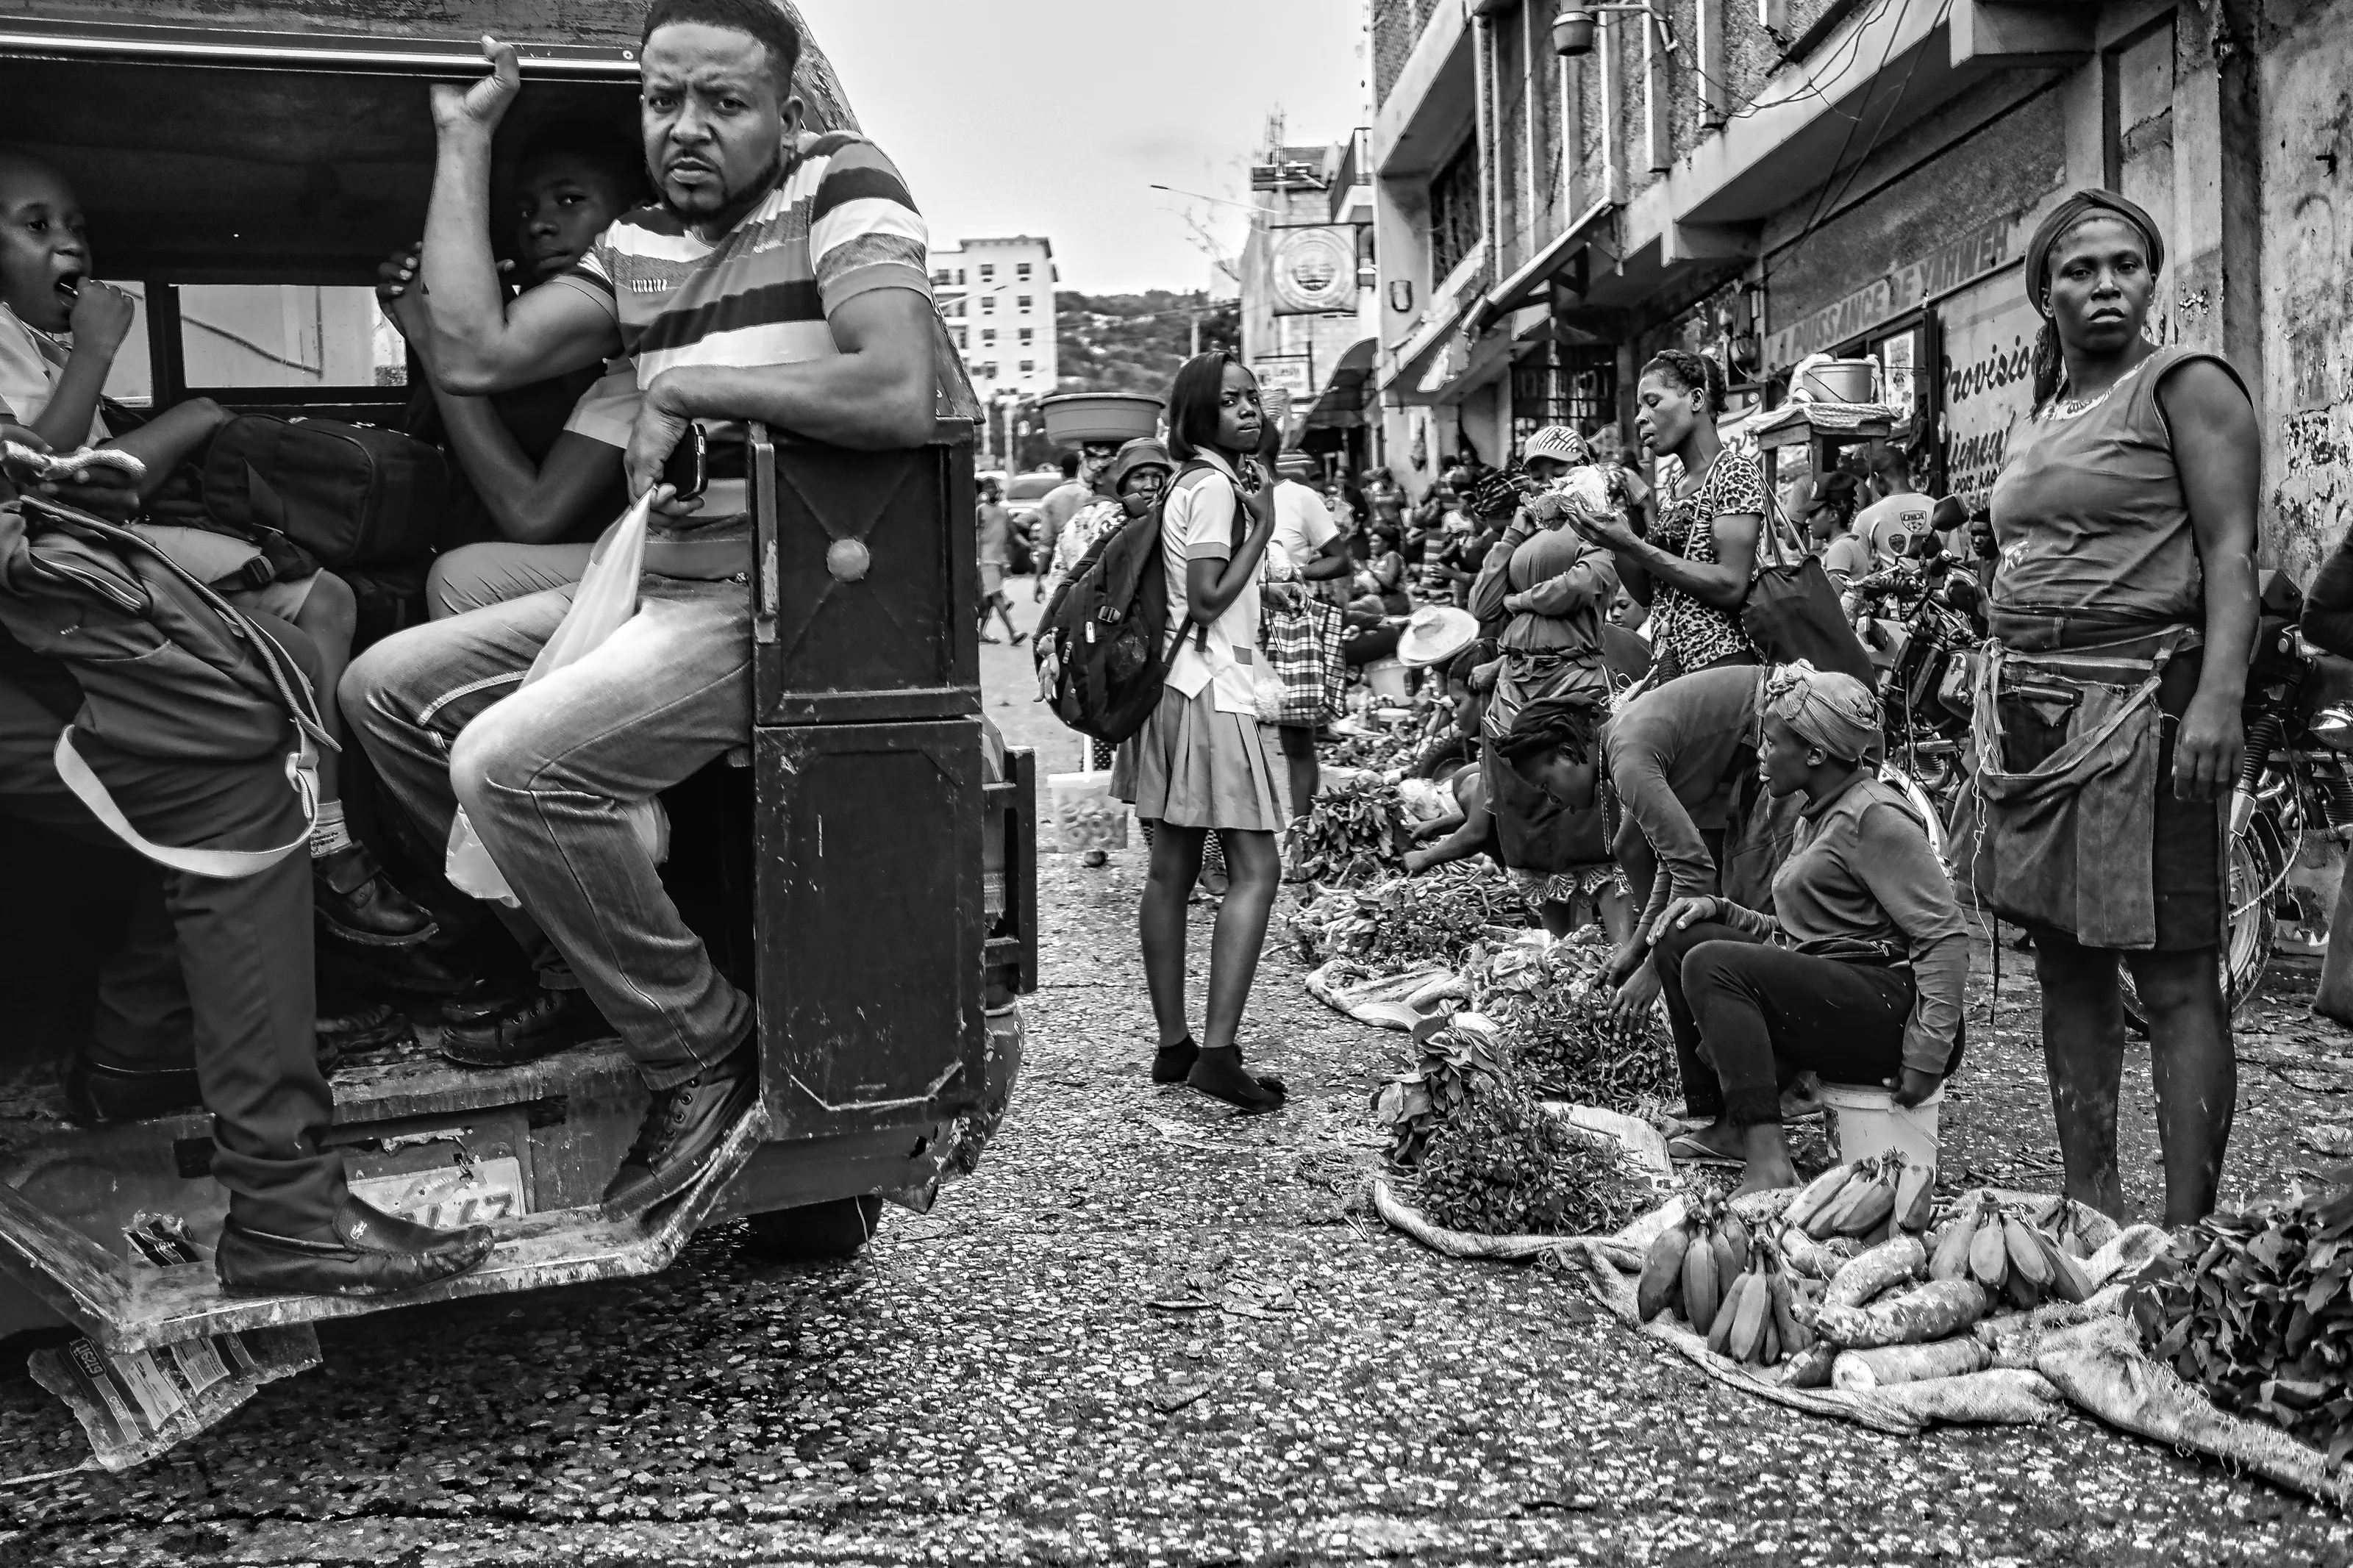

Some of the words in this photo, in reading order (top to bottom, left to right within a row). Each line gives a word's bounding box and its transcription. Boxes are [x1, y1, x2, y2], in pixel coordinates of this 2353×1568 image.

[1791, 282, 1885, 360] PUISSANCE
[1889, 268, 1915, 315] DE
[1920, 220, 2010, 298] YAHWEH
[1943, 334, 2030, 404] Provisio
